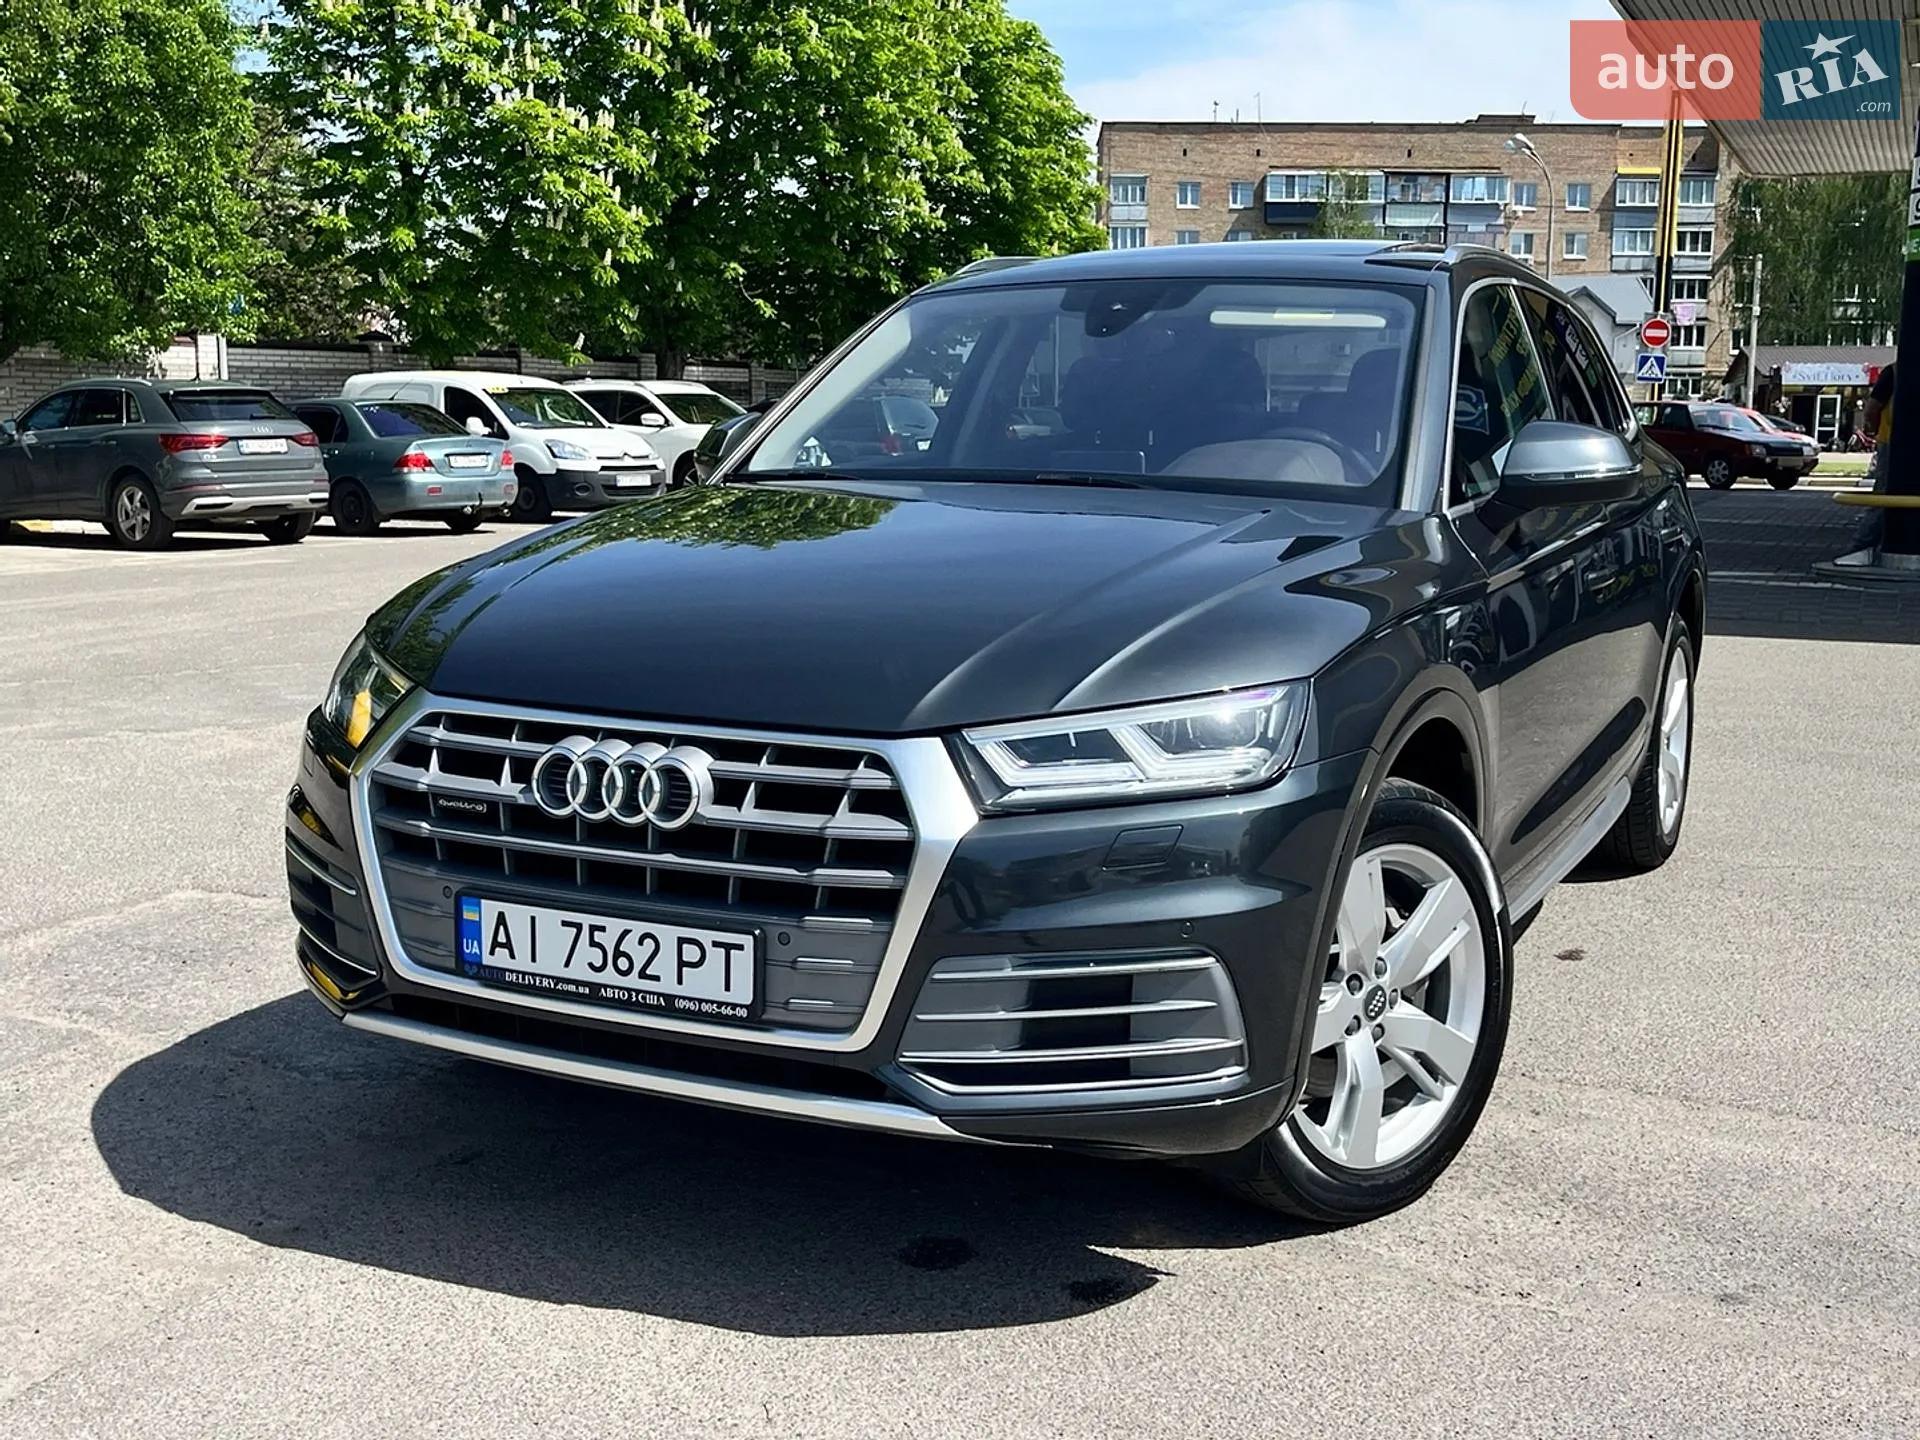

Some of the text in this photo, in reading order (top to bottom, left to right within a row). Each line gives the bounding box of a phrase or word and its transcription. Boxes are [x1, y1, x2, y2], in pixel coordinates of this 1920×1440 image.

[463, 938, 480, 956] UA
[488, 910, 745, 993] AI 7562 PT
[638, 994, 666, 1007] США
[674, 999, 748, 1018] (096) 005-66-00
